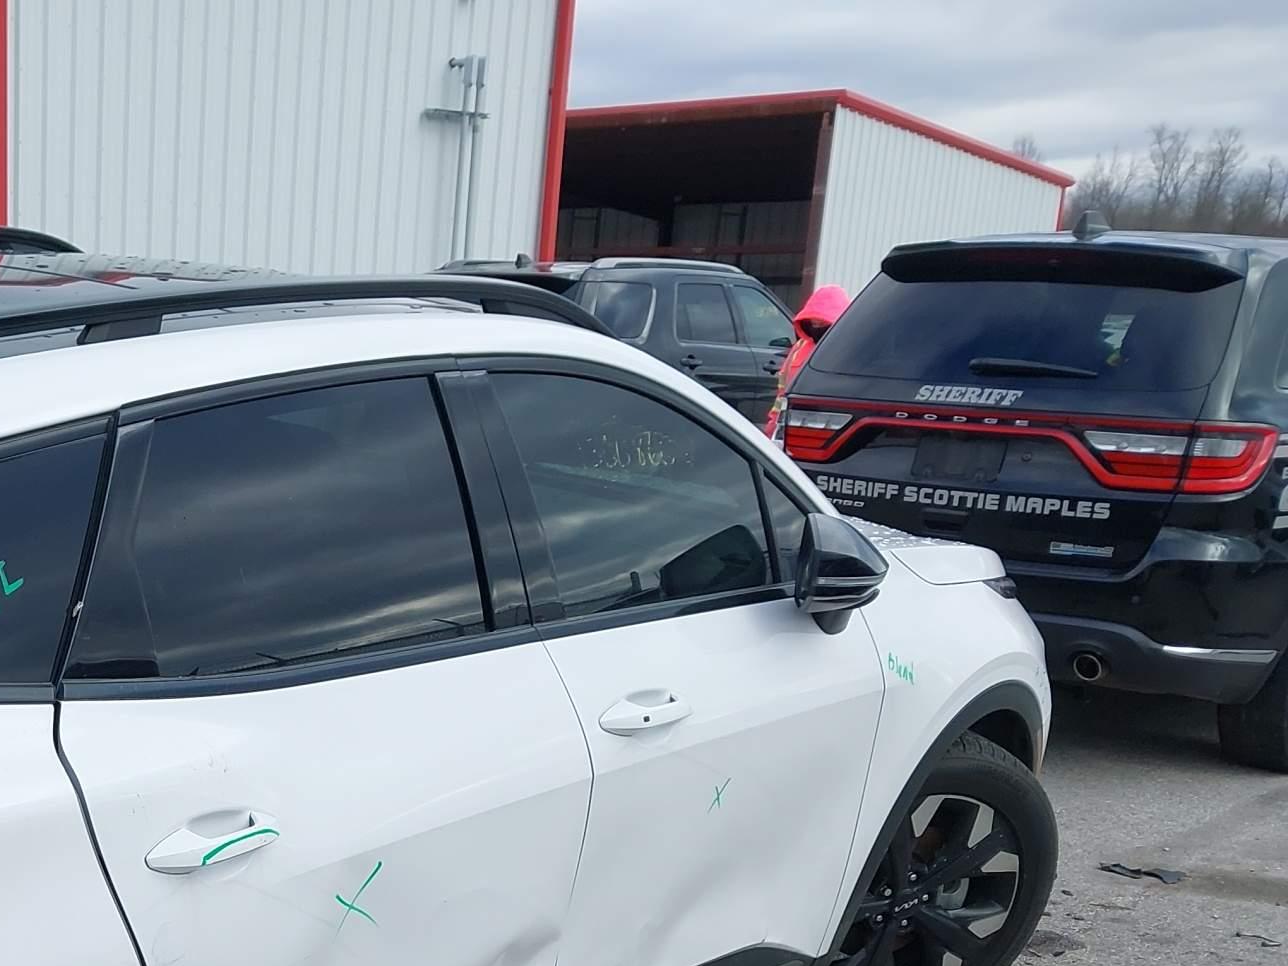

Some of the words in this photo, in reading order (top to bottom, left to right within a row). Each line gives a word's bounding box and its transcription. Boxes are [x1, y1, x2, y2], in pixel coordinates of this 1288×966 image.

[915, 384, 1025, 407] SHERIFF
[895, 411, 1030, 427] DODGE
[816, 475, 900, 500] SHERIFF
[903, 486, 1001, 511] SCOTTIE
[1005, 495, 1111, 519] MAPLES
